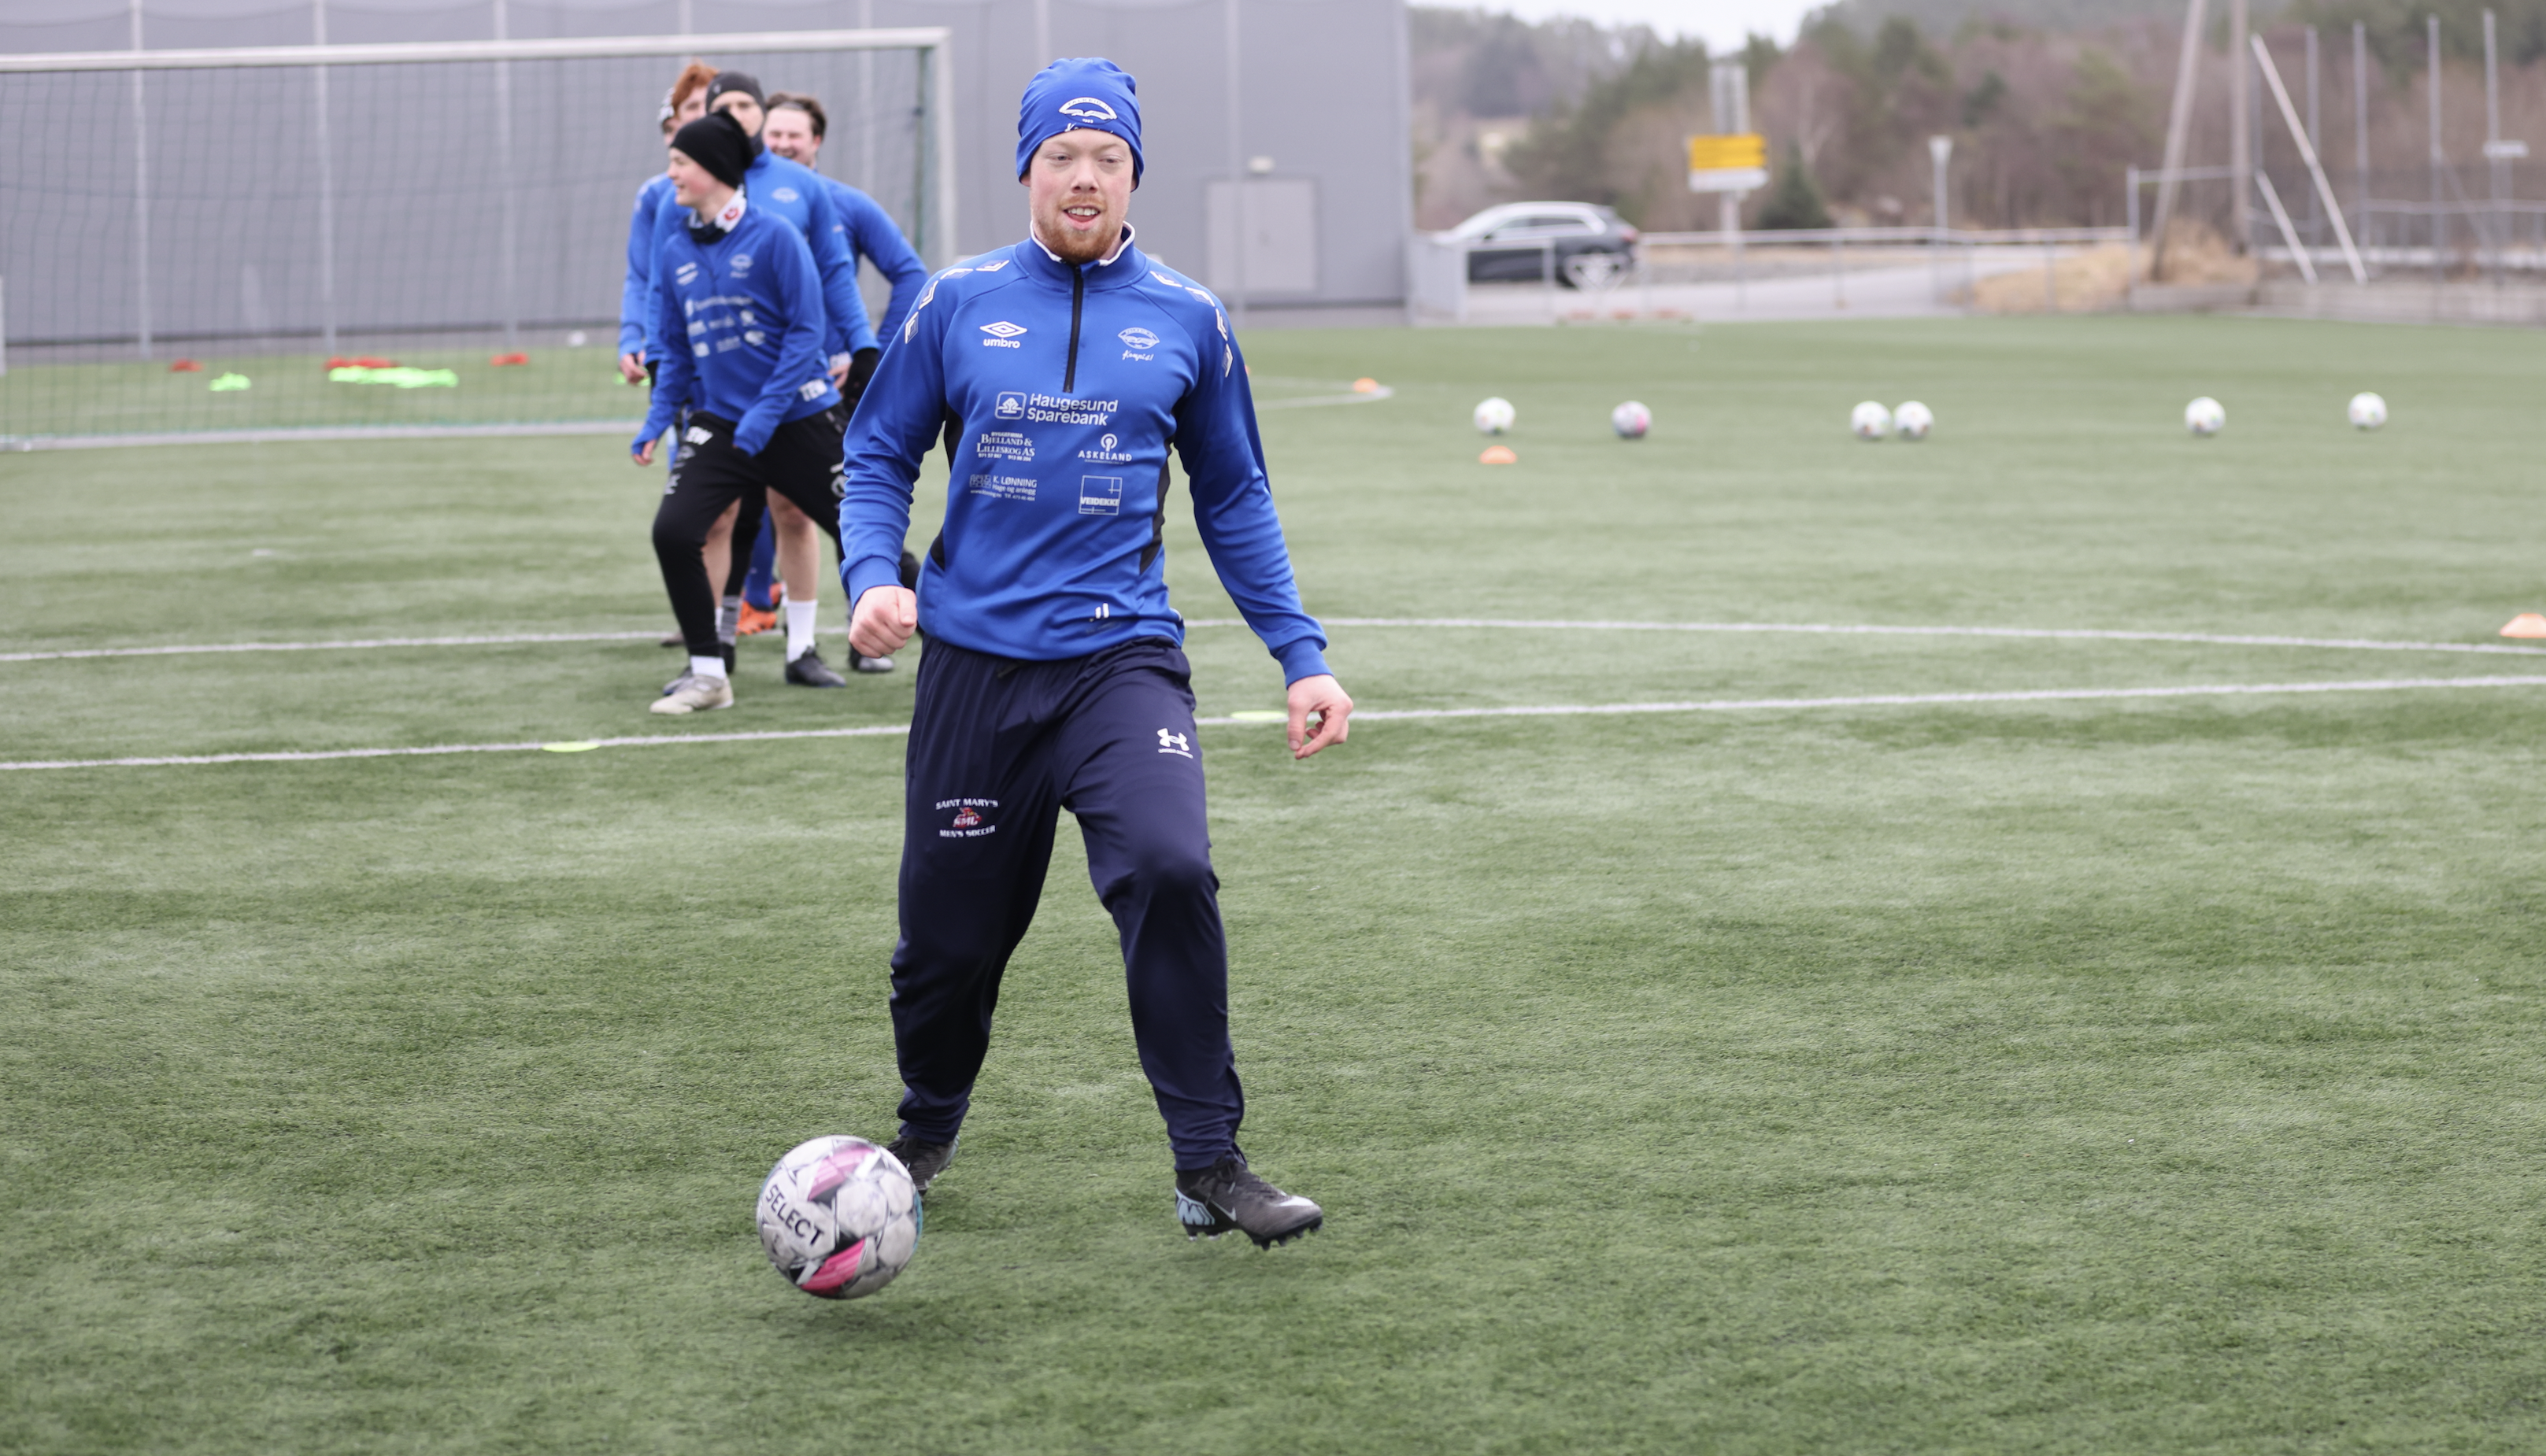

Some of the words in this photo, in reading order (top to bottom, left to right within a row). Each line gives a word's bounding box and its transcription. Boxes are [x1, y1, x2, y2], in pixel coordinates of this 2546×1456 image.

[983, 338, 1021, 349] umbro
[1029, 393, 1119, 412] Haugesund
[1027, 407, 1108, 426] Sparebank
[1022, 447, 1036, 456] AS
[1078, 449, 1133, 462] ASKELAND
[1001, 476, 1038, 488] LØNNING
[1080, 497, 1120, 507] VEIDEKKE
[935, 798, 961, 810] SAINT
[963, 798, 999, 807] MARY'S
[939, 829, 964, 838] MEN'S
[965, 824, 996, 837] SOCCER
[765, 1184, 825, 1247] SELECT
